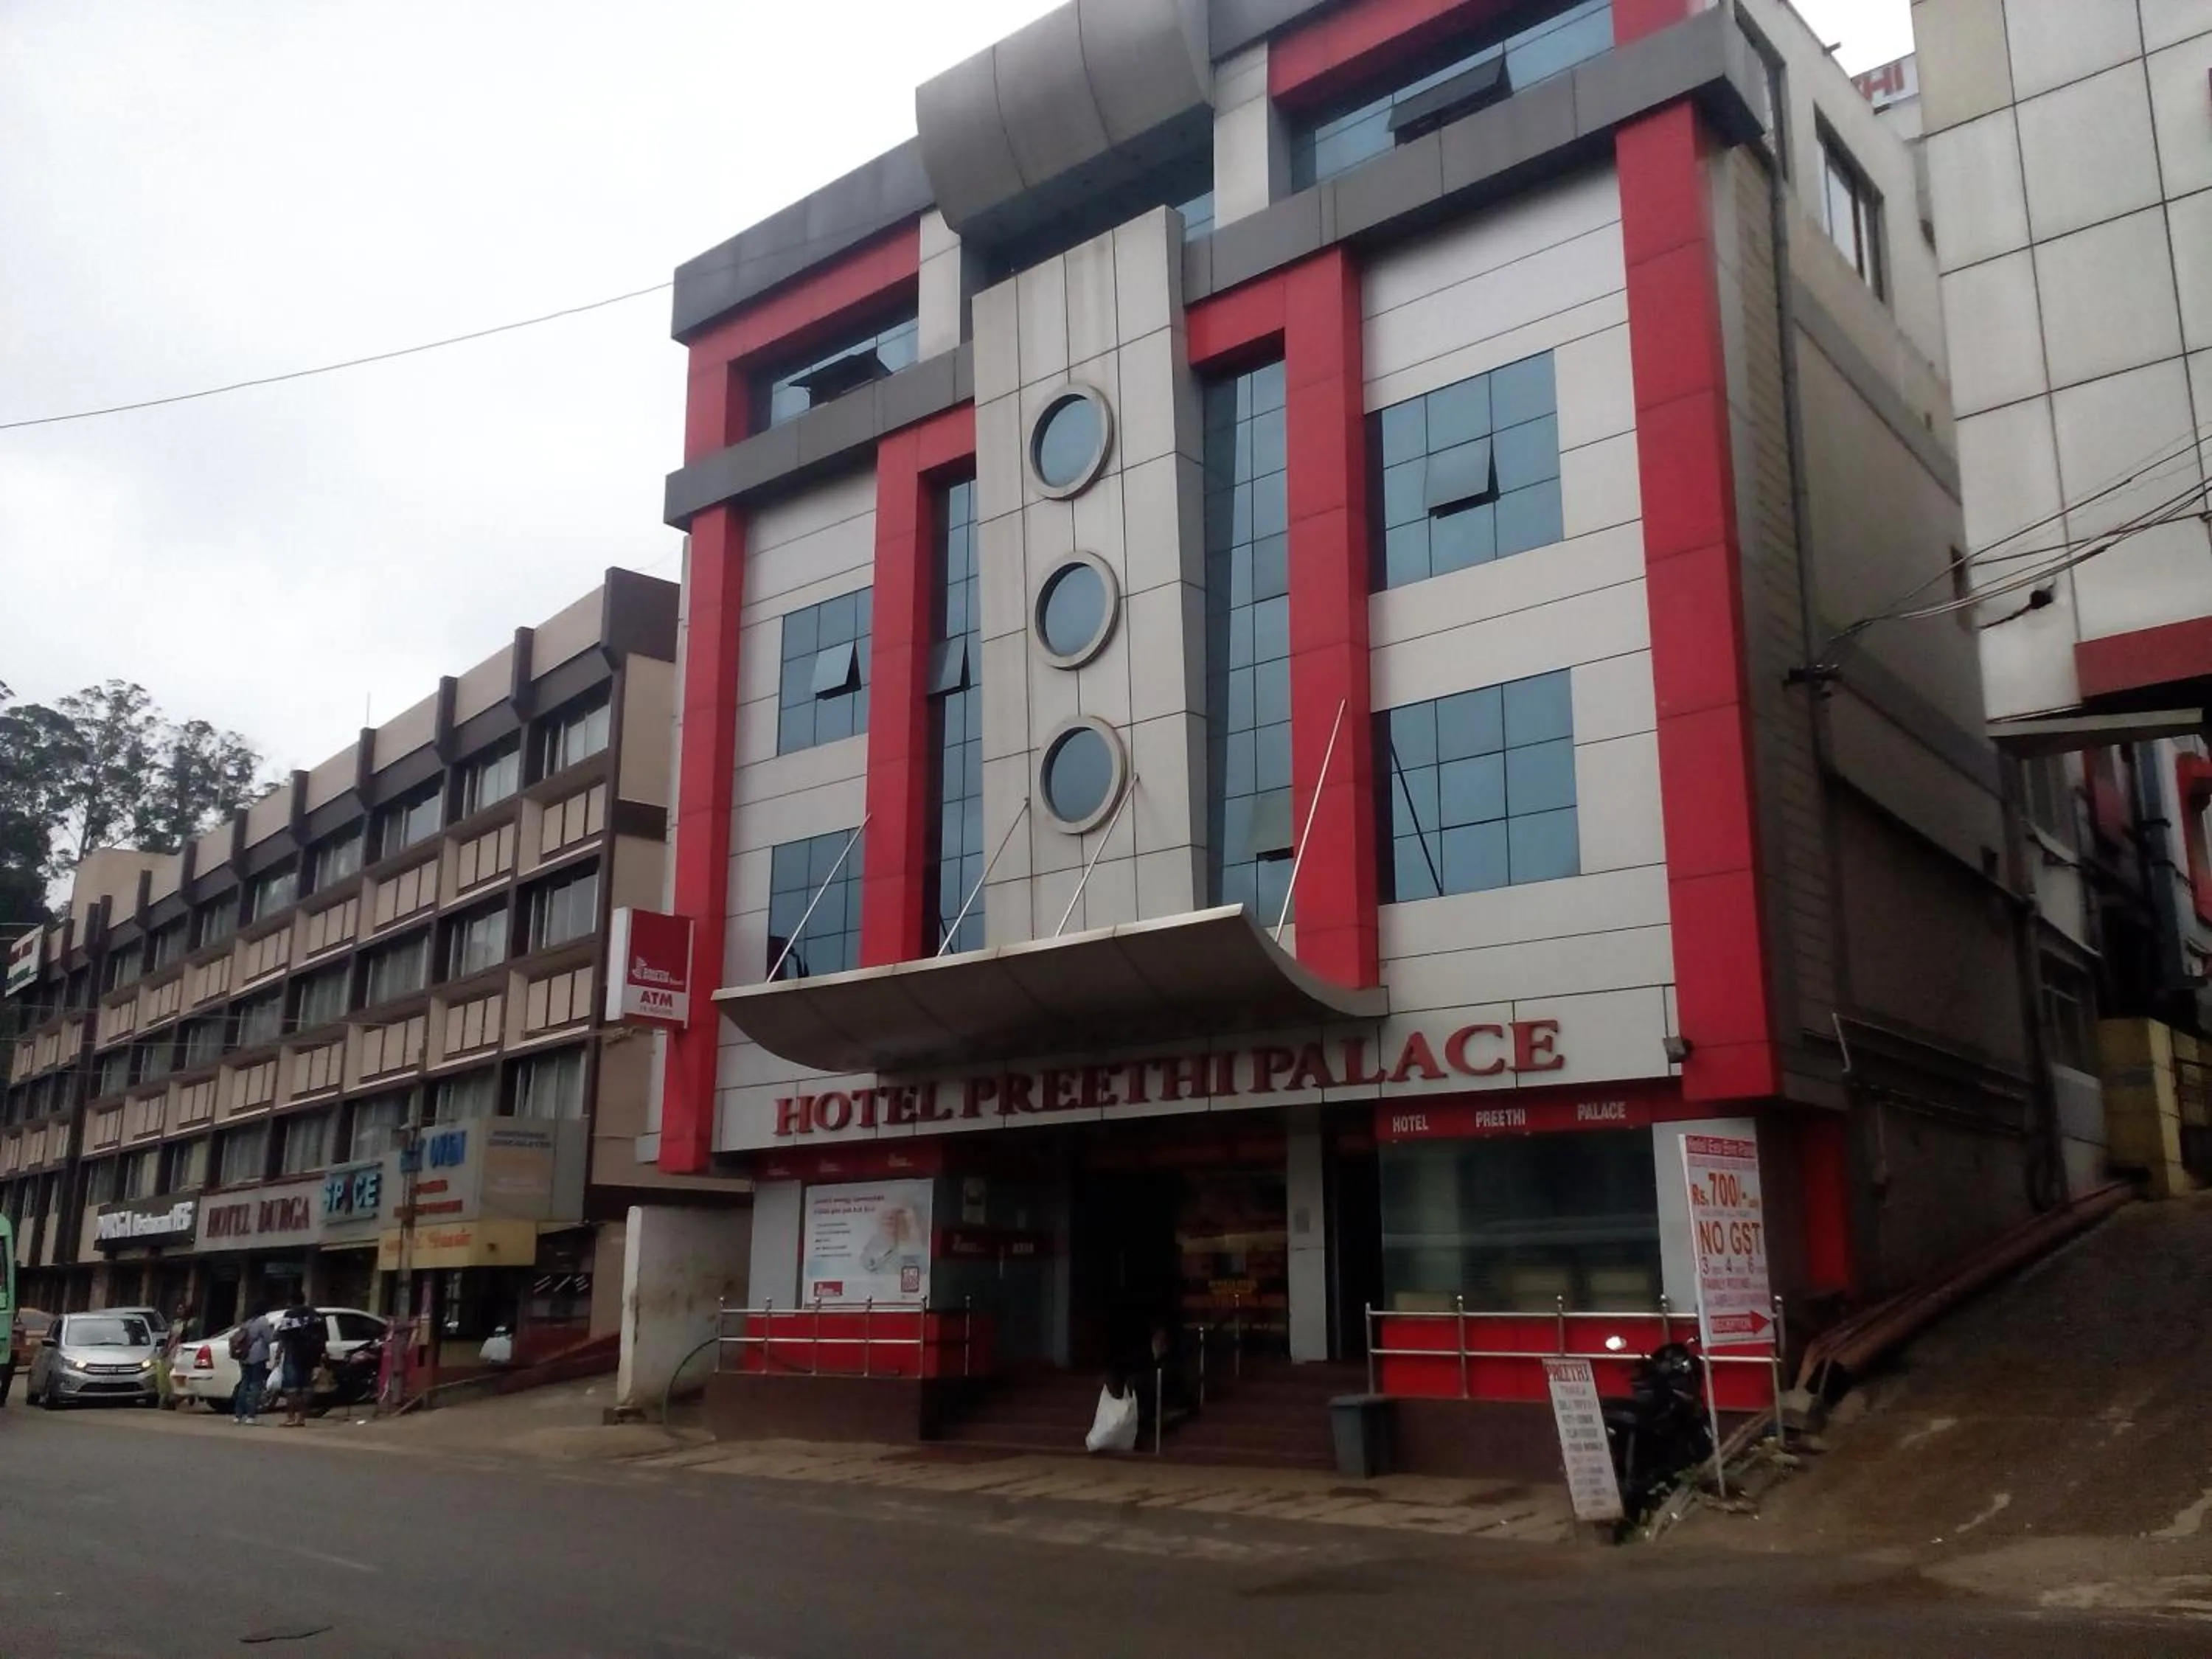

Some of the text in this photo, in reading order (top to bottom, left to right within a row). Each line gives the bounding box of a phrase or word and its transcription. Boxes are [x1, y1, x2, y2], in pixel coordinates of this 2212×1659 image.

[640, 990, 672, 1007] ATM
[773, 1018, 1566, 1137] HOTEL PREETHI PALACE
[1393, 1102, 1626, 1133] HOTEL PREETHI PALACE
[206, 1203, 251, 1239] HOTEL
[256, 1195, 310, 1234] DURGA
[1699, 1220, 1761, 1255] NO GST
